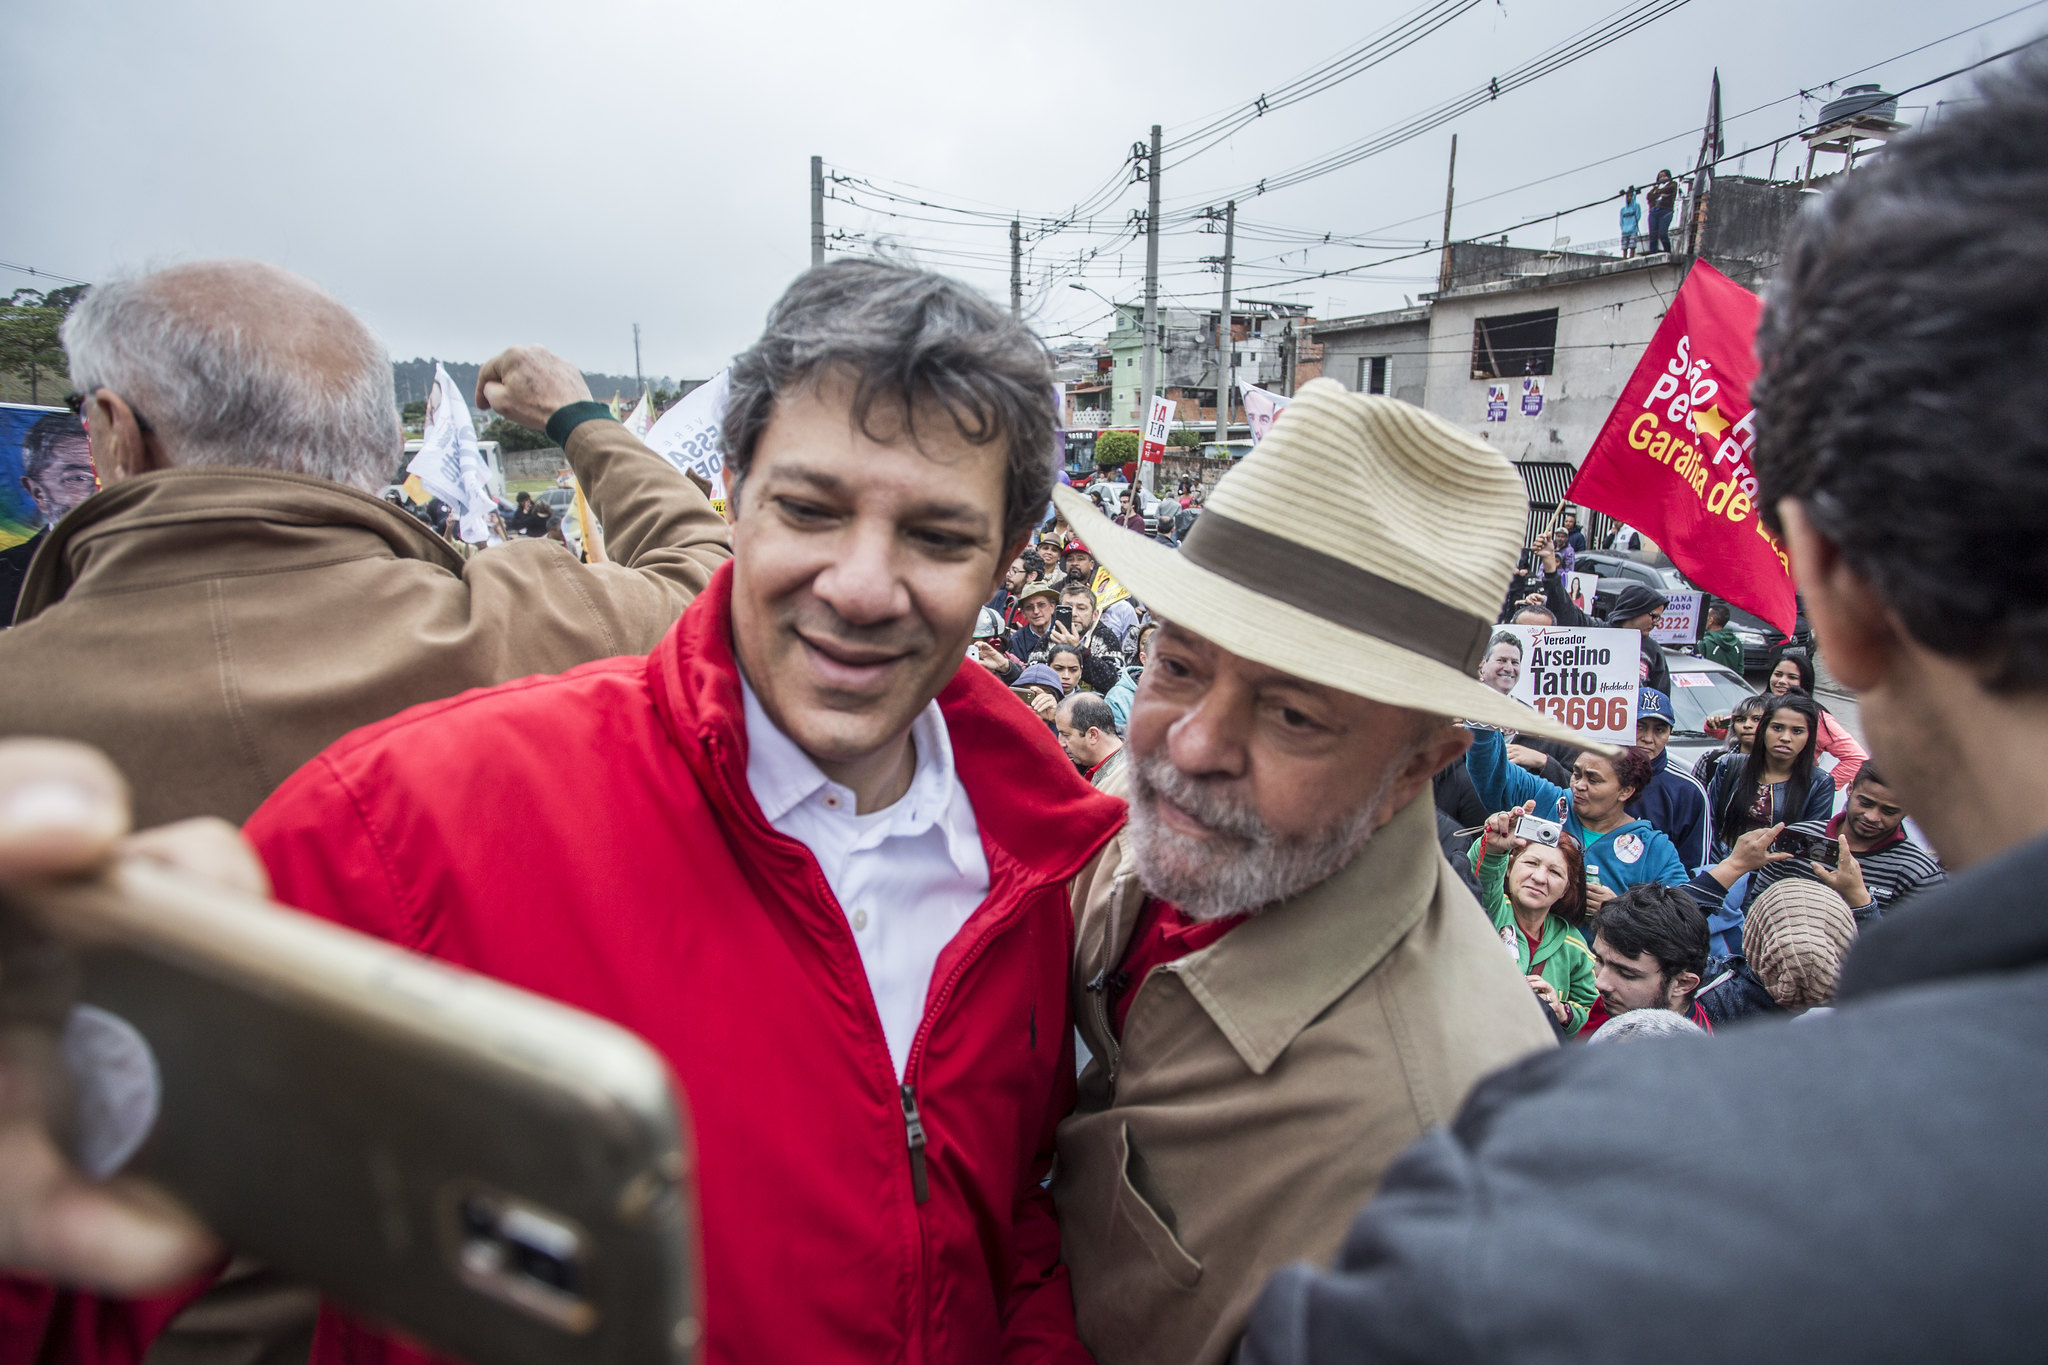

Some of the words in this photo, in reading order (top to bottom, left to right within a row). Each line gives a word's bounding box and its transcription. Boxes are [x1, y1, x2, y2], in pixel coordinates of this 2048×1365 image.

[1668, 335, 1719, 406] São
[1707, 477, 1751, 522] de
[1656, 616, 1690, 630] 3222
[1543, 635, 1587, 646] Vereador
[1531, 645, 1611, 667] Arselino
[1530, 667, 1598, 696] Tatto
[1533, 697, 1629, 731] 13696
